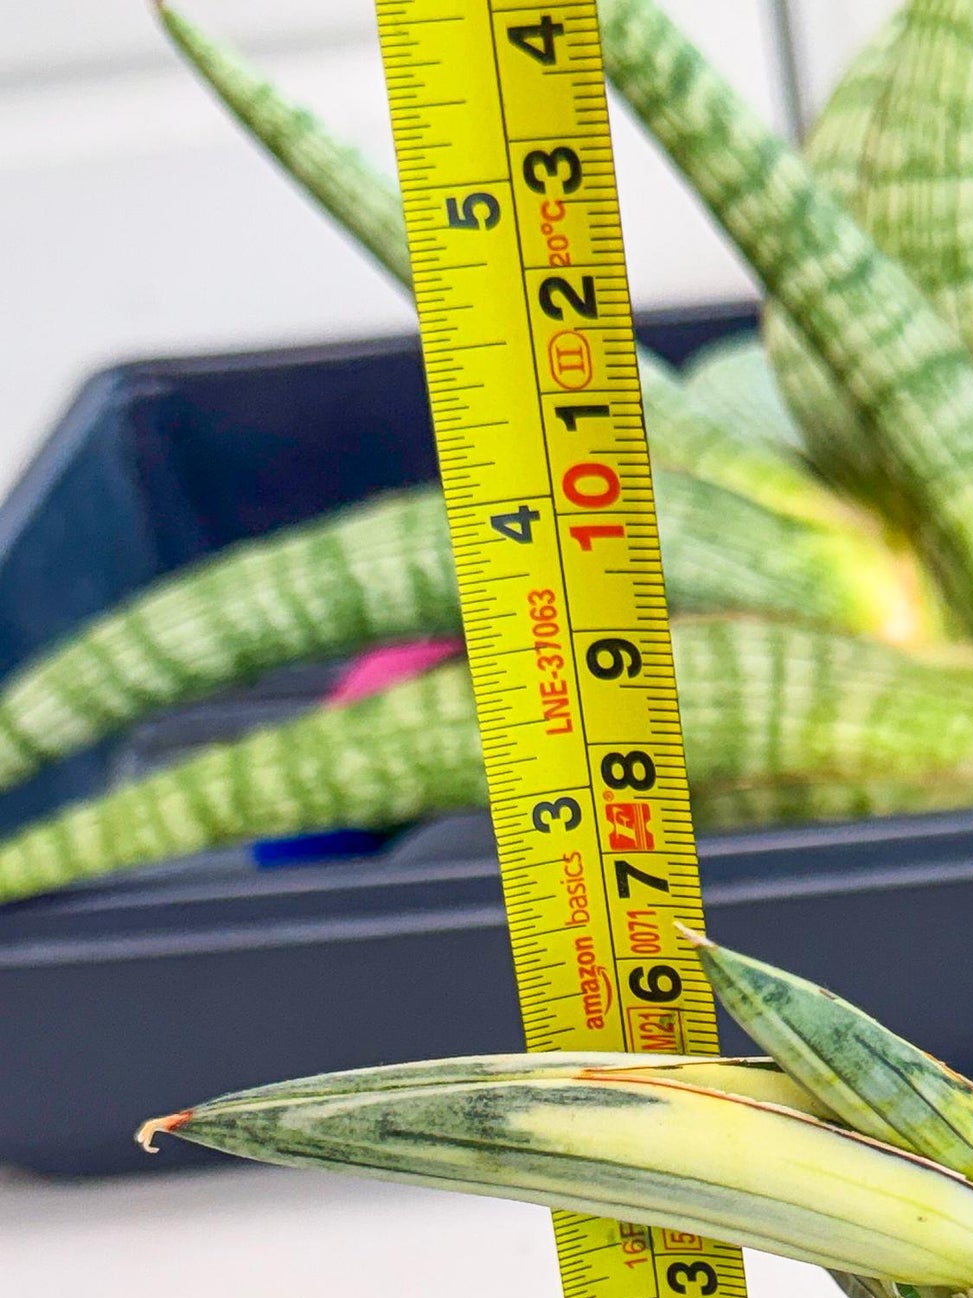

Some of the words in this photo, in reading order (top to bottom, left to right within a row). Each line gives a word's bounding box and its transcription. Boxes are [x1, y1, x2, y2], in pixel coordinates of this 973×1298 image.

[508, 16, 563, 65] 4
[523, 146, 581, 194] 3
[446, 192, 499, 231] 5
[539, 276, 598, 321] 2
[555, 404, 610, 432] 1
[491, 505, 541, 545] 4
[561, 463, 625, 552] 10
[528, 588, 574, 736] LNE-37063
[586, 638, 642, 681] 9
[601, 750, 657, 792] 8
[533, 797, 582, 833] 3
[561, 851, 590, 927] basics
[615, 860, 669, 899] 7
[627, 909, 660, 954] 0071
[574, 935, 605, 1030] amazon
[629, 965, 683, 1002] 6
[667, 1261, 718, 1296] 3
